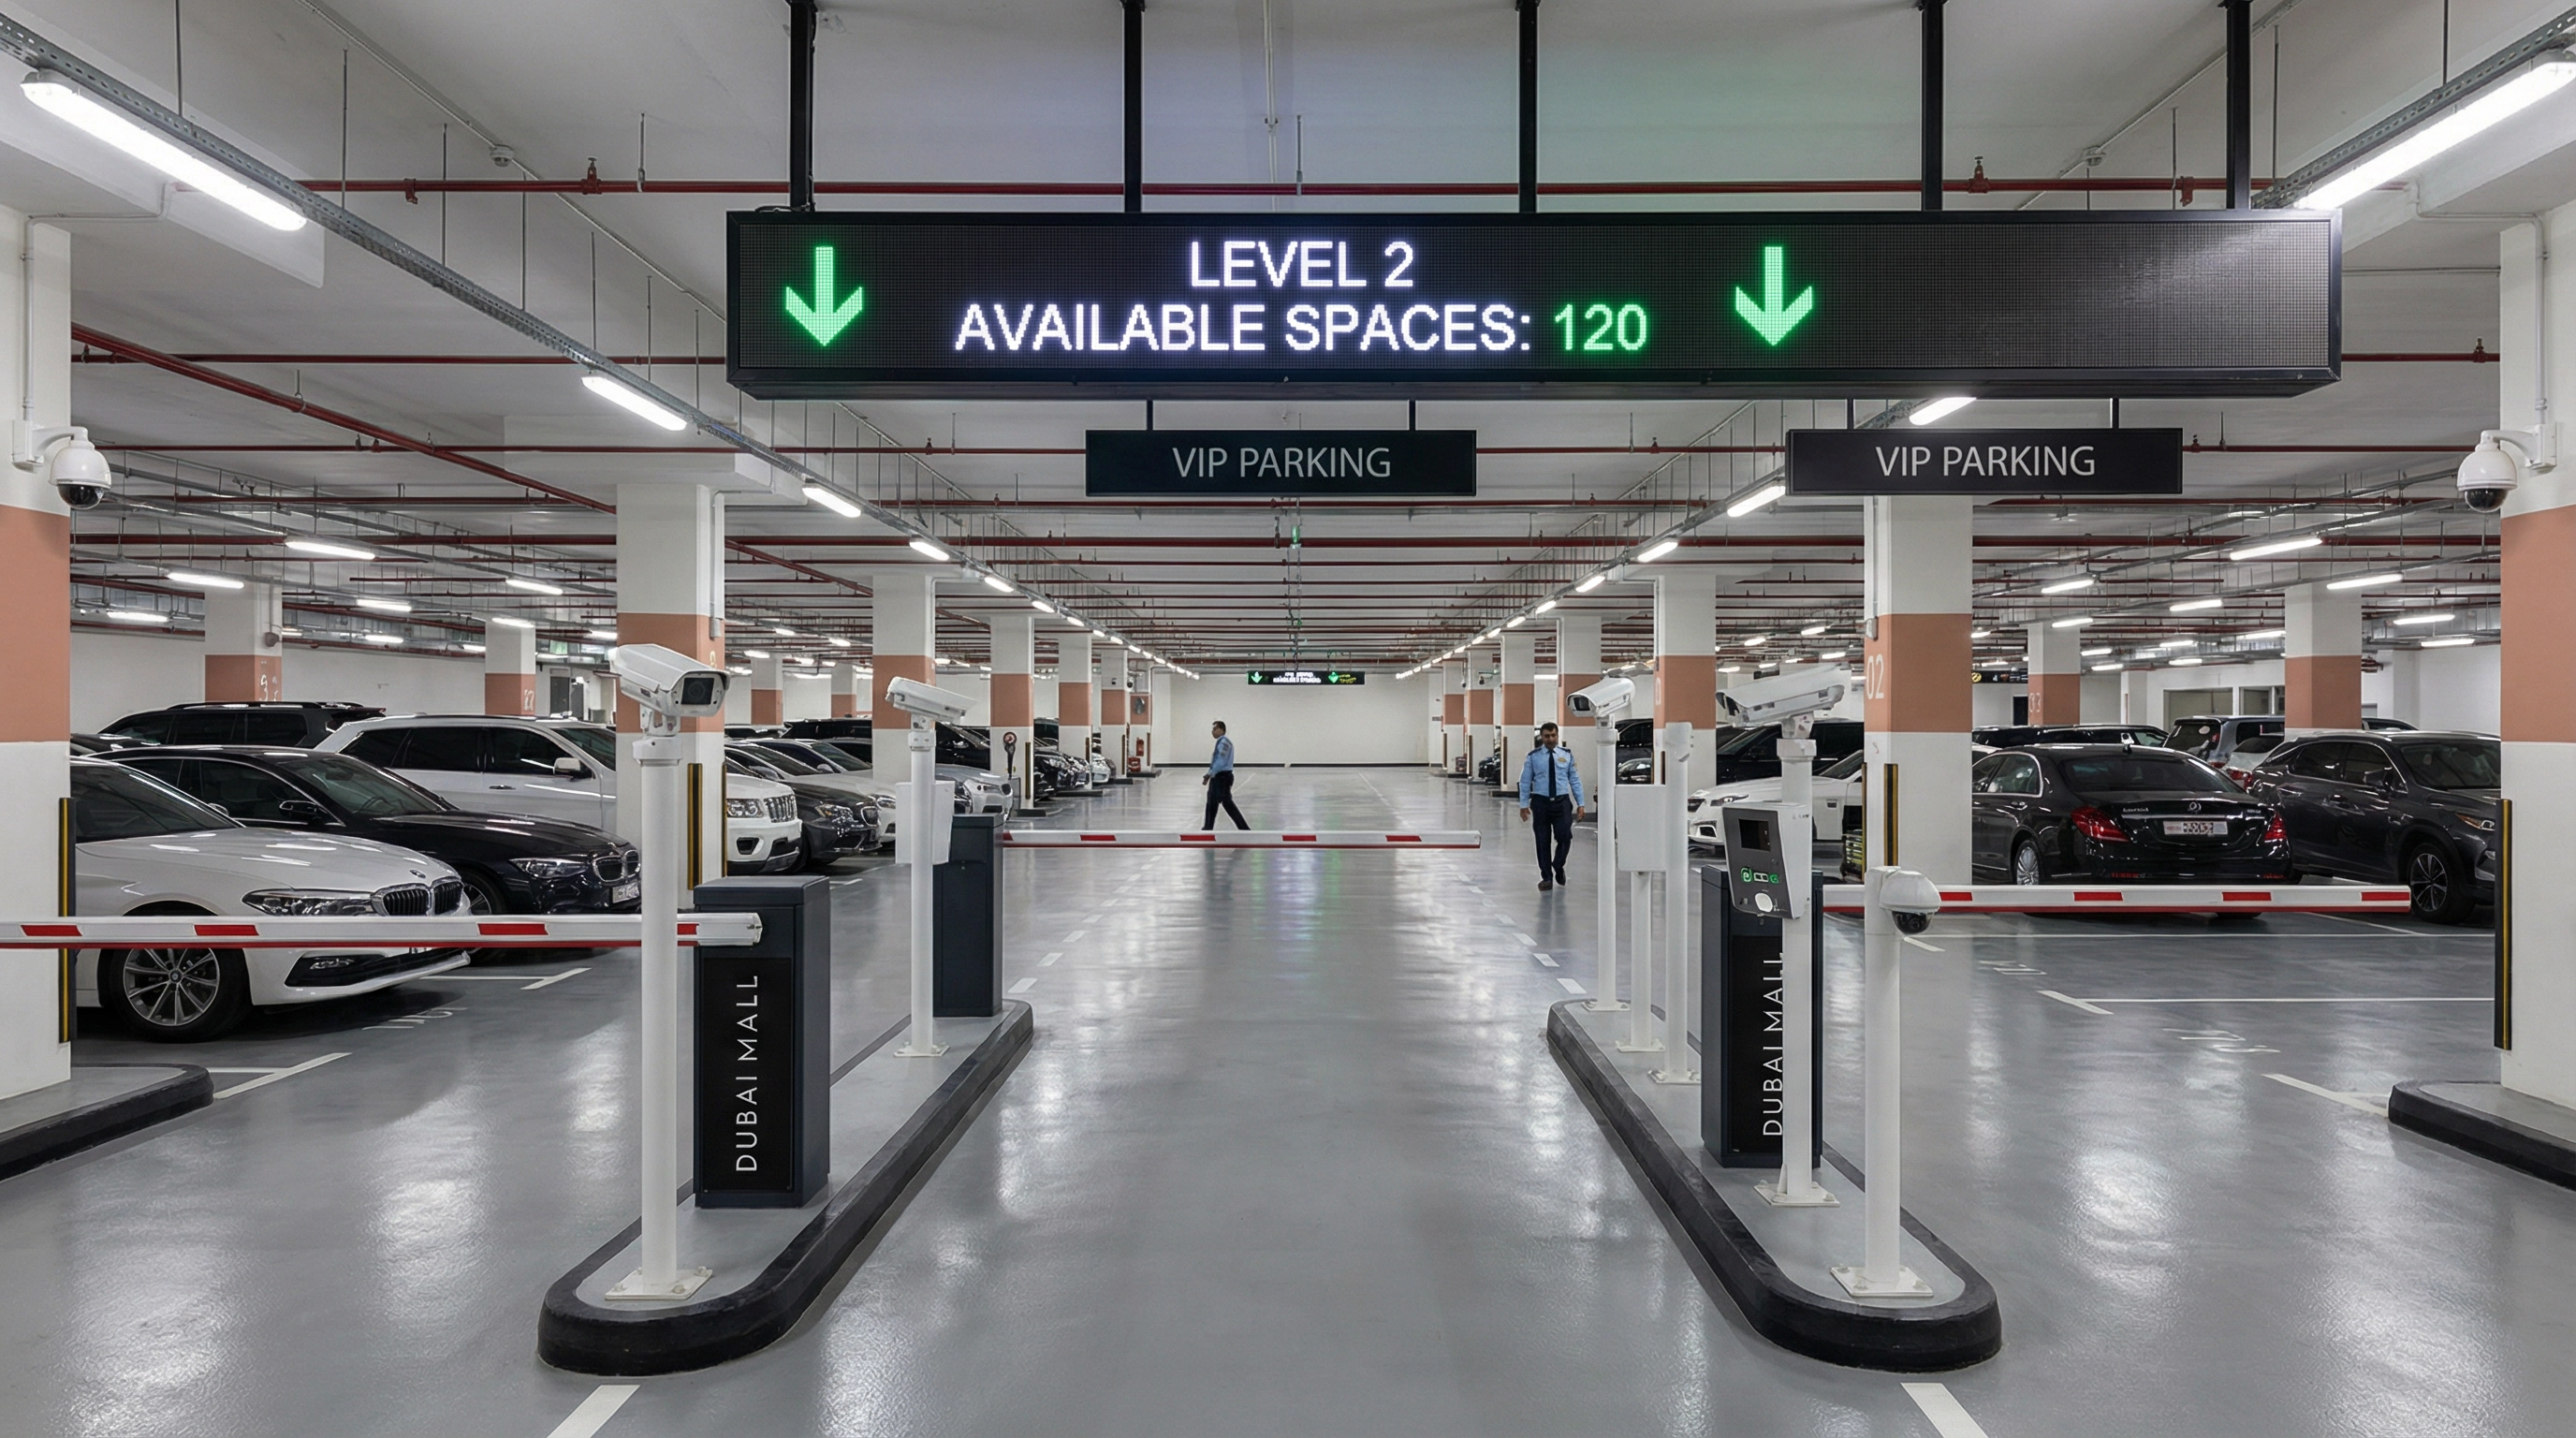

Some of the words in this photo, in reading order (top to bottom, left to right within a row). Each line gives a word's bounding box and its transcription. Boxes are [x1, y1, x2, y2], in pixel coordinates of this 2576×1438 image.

[1190, 239, 1368, 288] LEVEL
[1383, 239, 1414, 288] 2
[954, 302, 1266, 352] AVAILABLE
[1284, 302, 1531, 352] SPACES:
[1554, 302, 1648, 352] 120
[1172, 447, 1228, 477] VIP
[1240, 447, 1391, 477] PARKING
[1875, 446, 1931, 477] VIP
[1943, 446, 2095, 477] PARKING
[1866, 653, 1884, 700] 02
[1762, 951, 1783, 1033] MALL
[735, 975, 758, 1062] MALL
[1762, 1046, 1783, 1137] DUBAI
[735, 1076, 758, 1172] DUBAI
